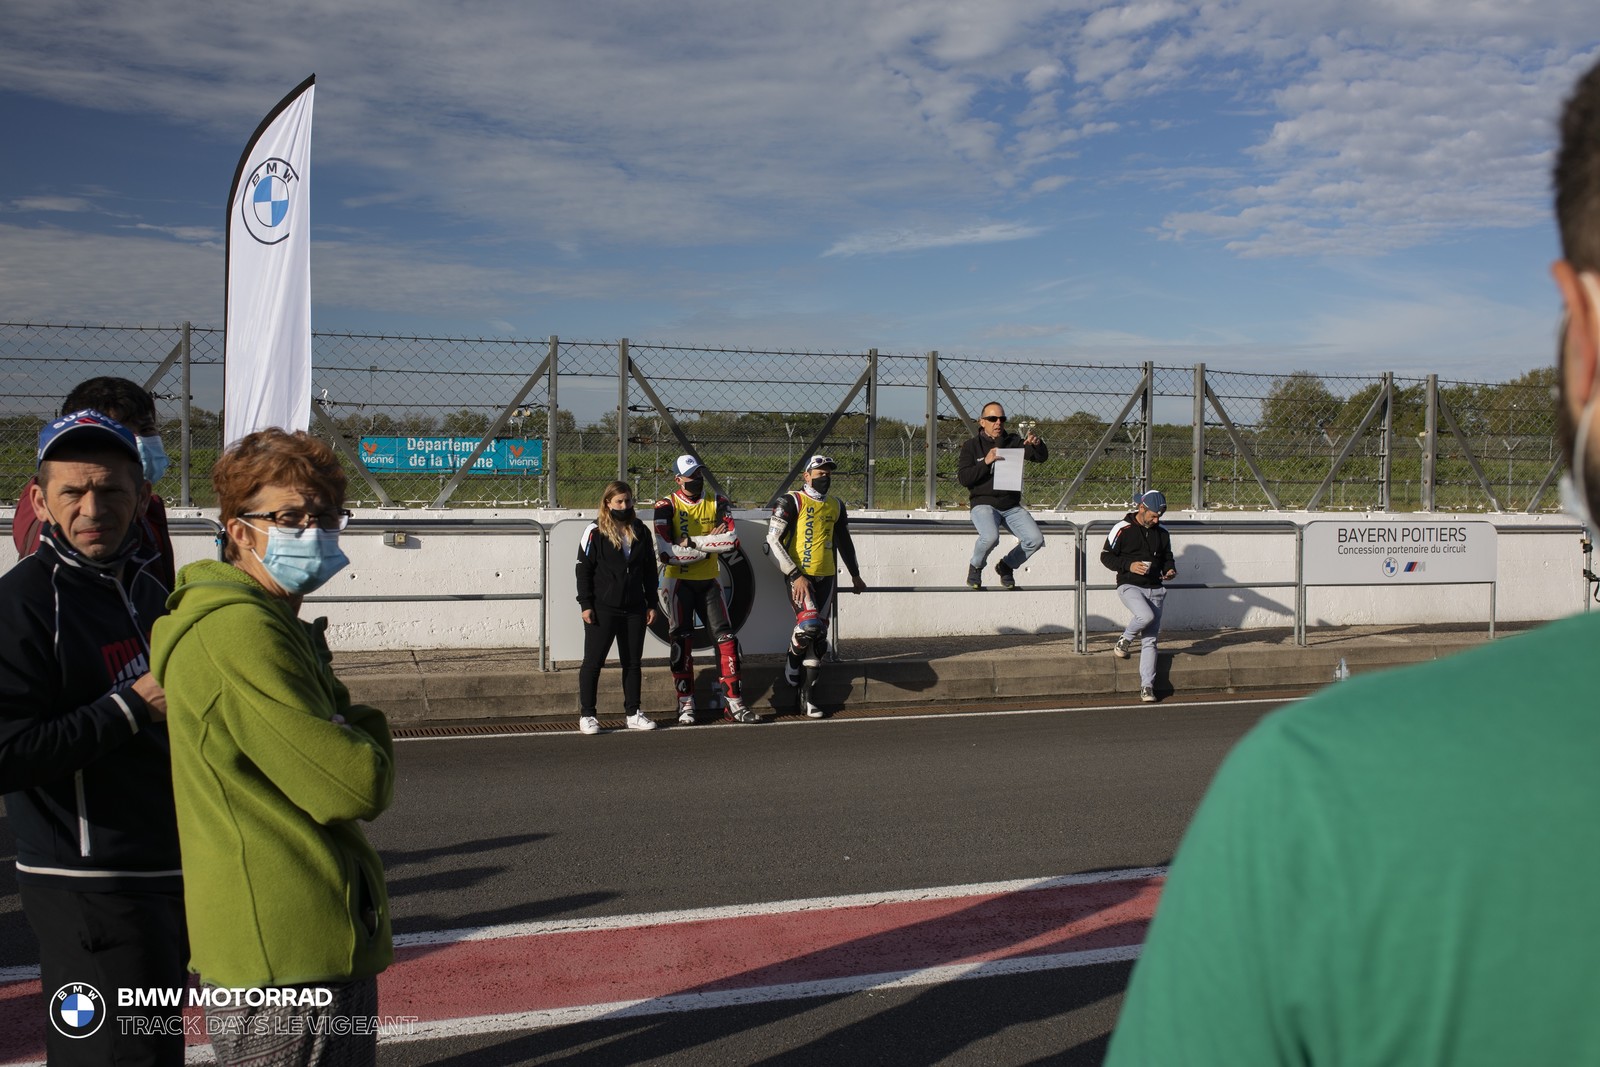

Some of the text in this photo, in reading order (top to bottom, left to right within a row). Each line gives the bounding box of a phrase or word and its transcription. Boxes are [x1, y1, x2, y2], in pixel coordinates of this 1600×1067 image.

[252, 163, 293, 187] BMW
[362, 456, 395, 464] vienne
[409, 454, 494, 468] de la Viene
[802, 507, 815, 568] TRACKDAYS
[1337, 527, 1467, 543] BAYERN POITIERS
[1337, 544, 1467, 556] Concession partenaire du circuit
